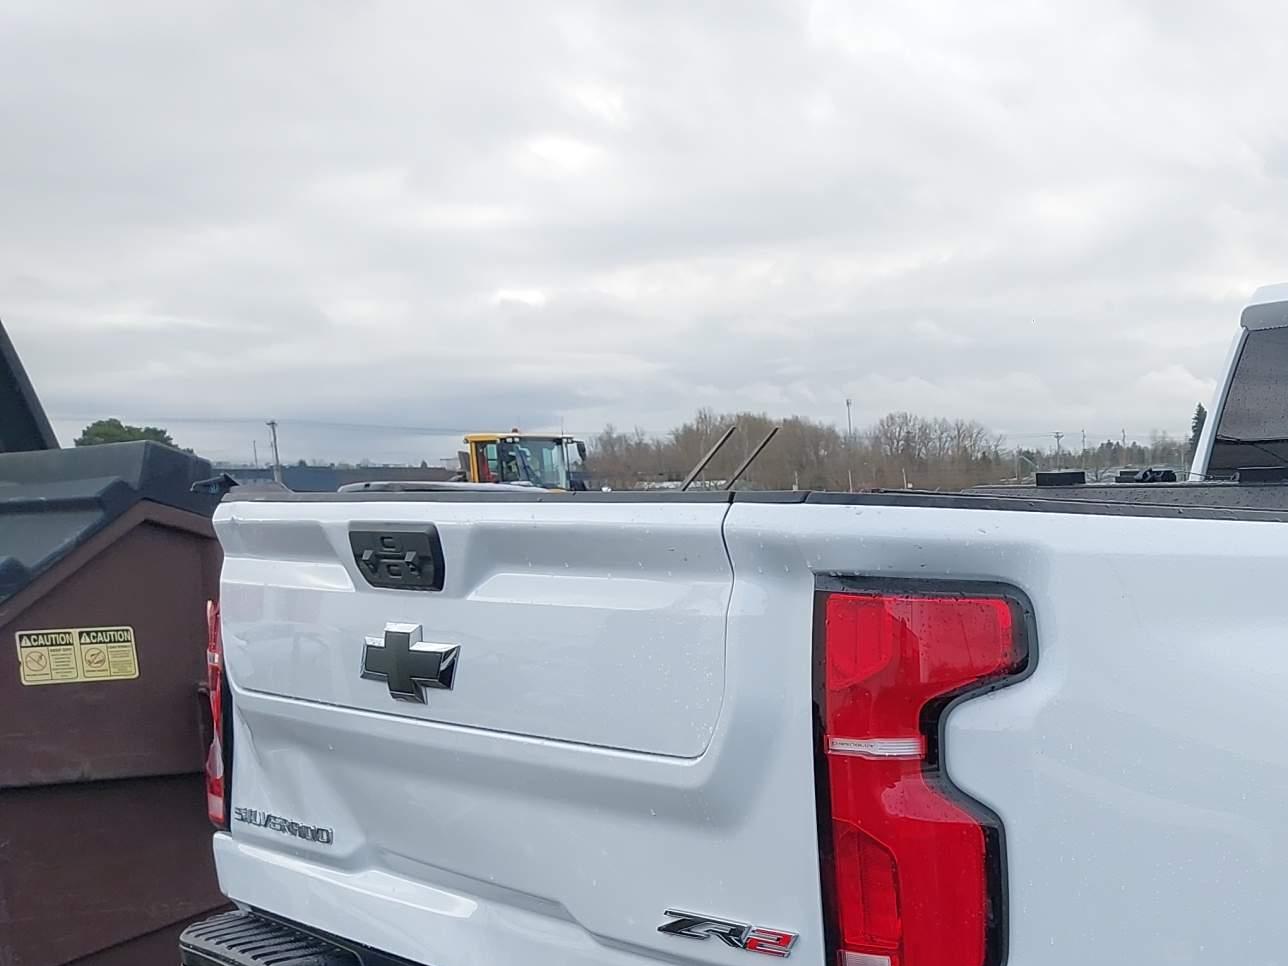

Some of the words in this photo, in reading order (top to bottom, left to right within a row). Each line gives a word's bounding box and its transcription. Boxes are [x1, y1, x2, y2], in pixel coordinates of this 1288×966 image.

[31, 634, 73, 645] CAUTION
[90, 631, 131, 642] CAUTION
[234, 807, 334, 845] SILVERADO
[657, 908, 800, 958] ZR2
